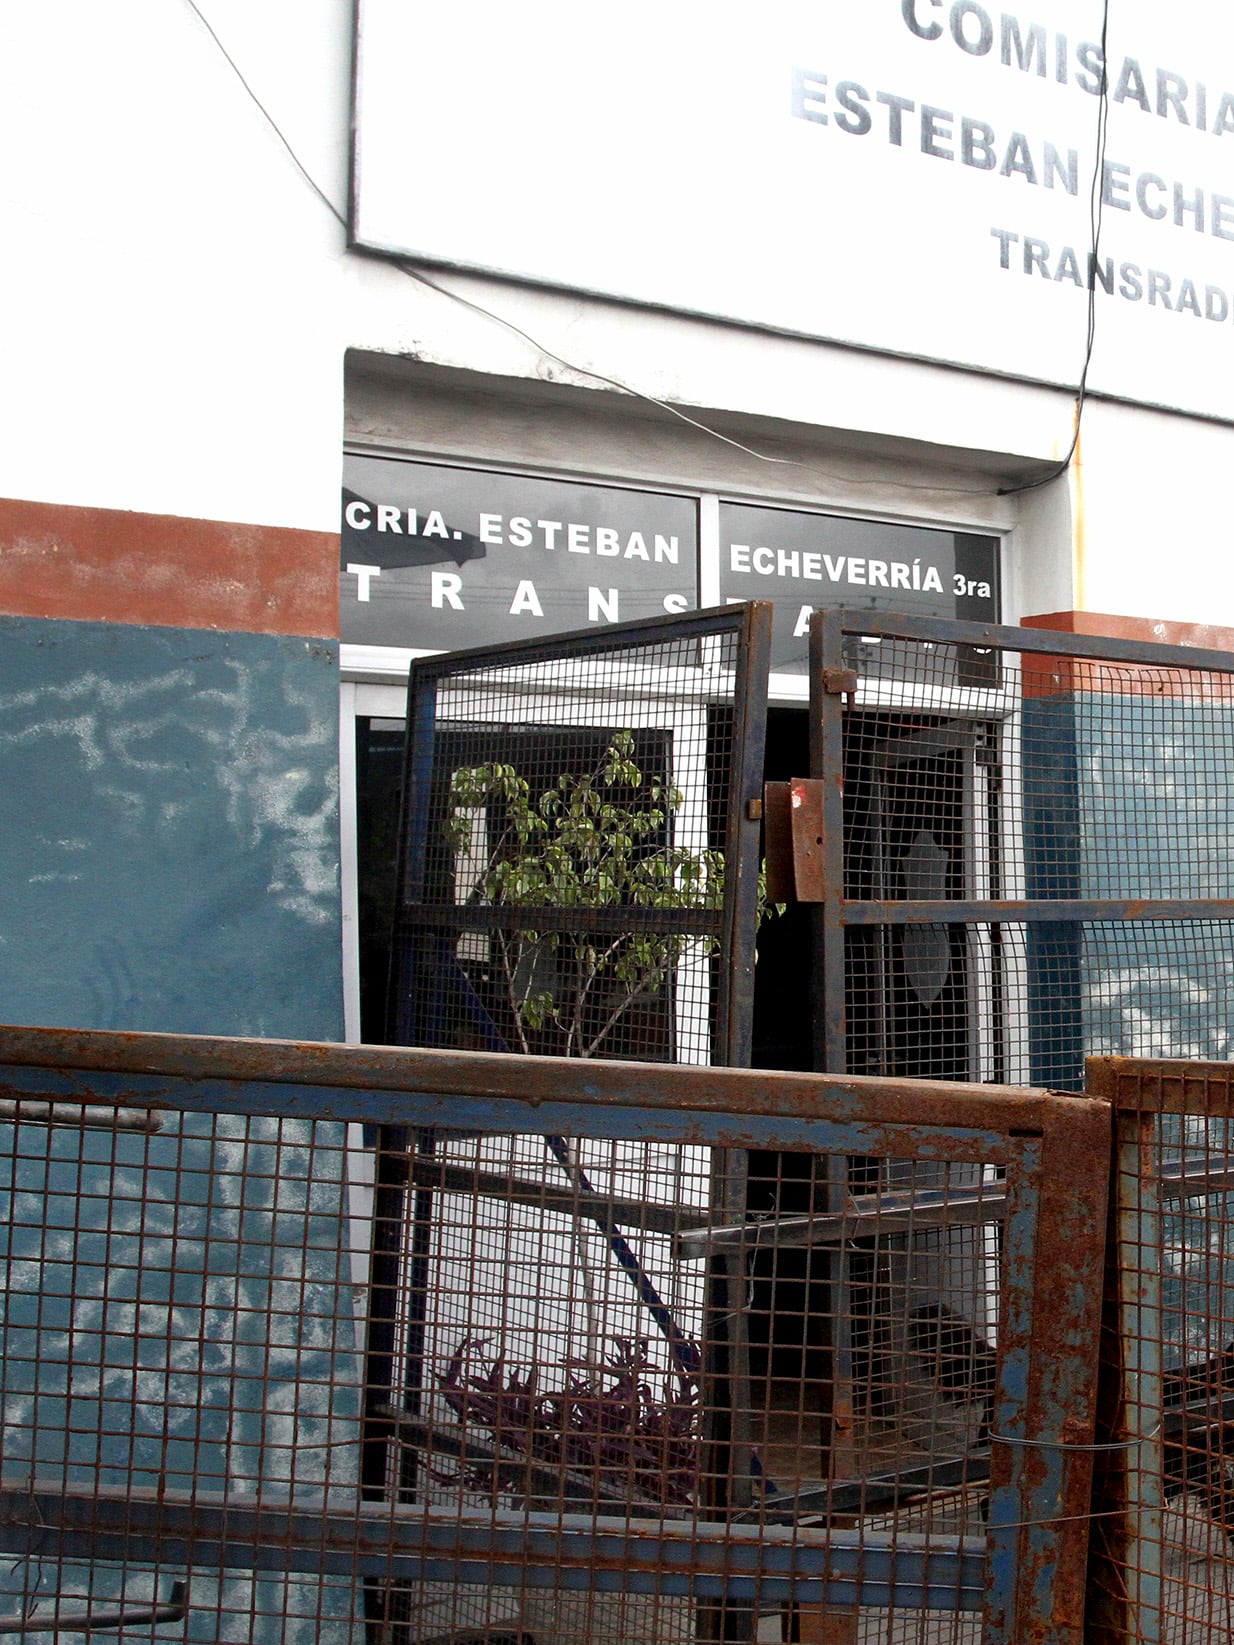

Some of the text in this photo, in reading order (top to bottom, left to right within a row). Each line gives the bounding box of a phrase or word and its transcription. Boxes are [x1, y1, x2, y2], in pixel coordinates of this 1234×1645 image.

[790, 64, 1080, 197] ESTEBAN
[345, 501, 991, 599] CRIA. ESTEBAN ECHEVERRÍA 3ra
